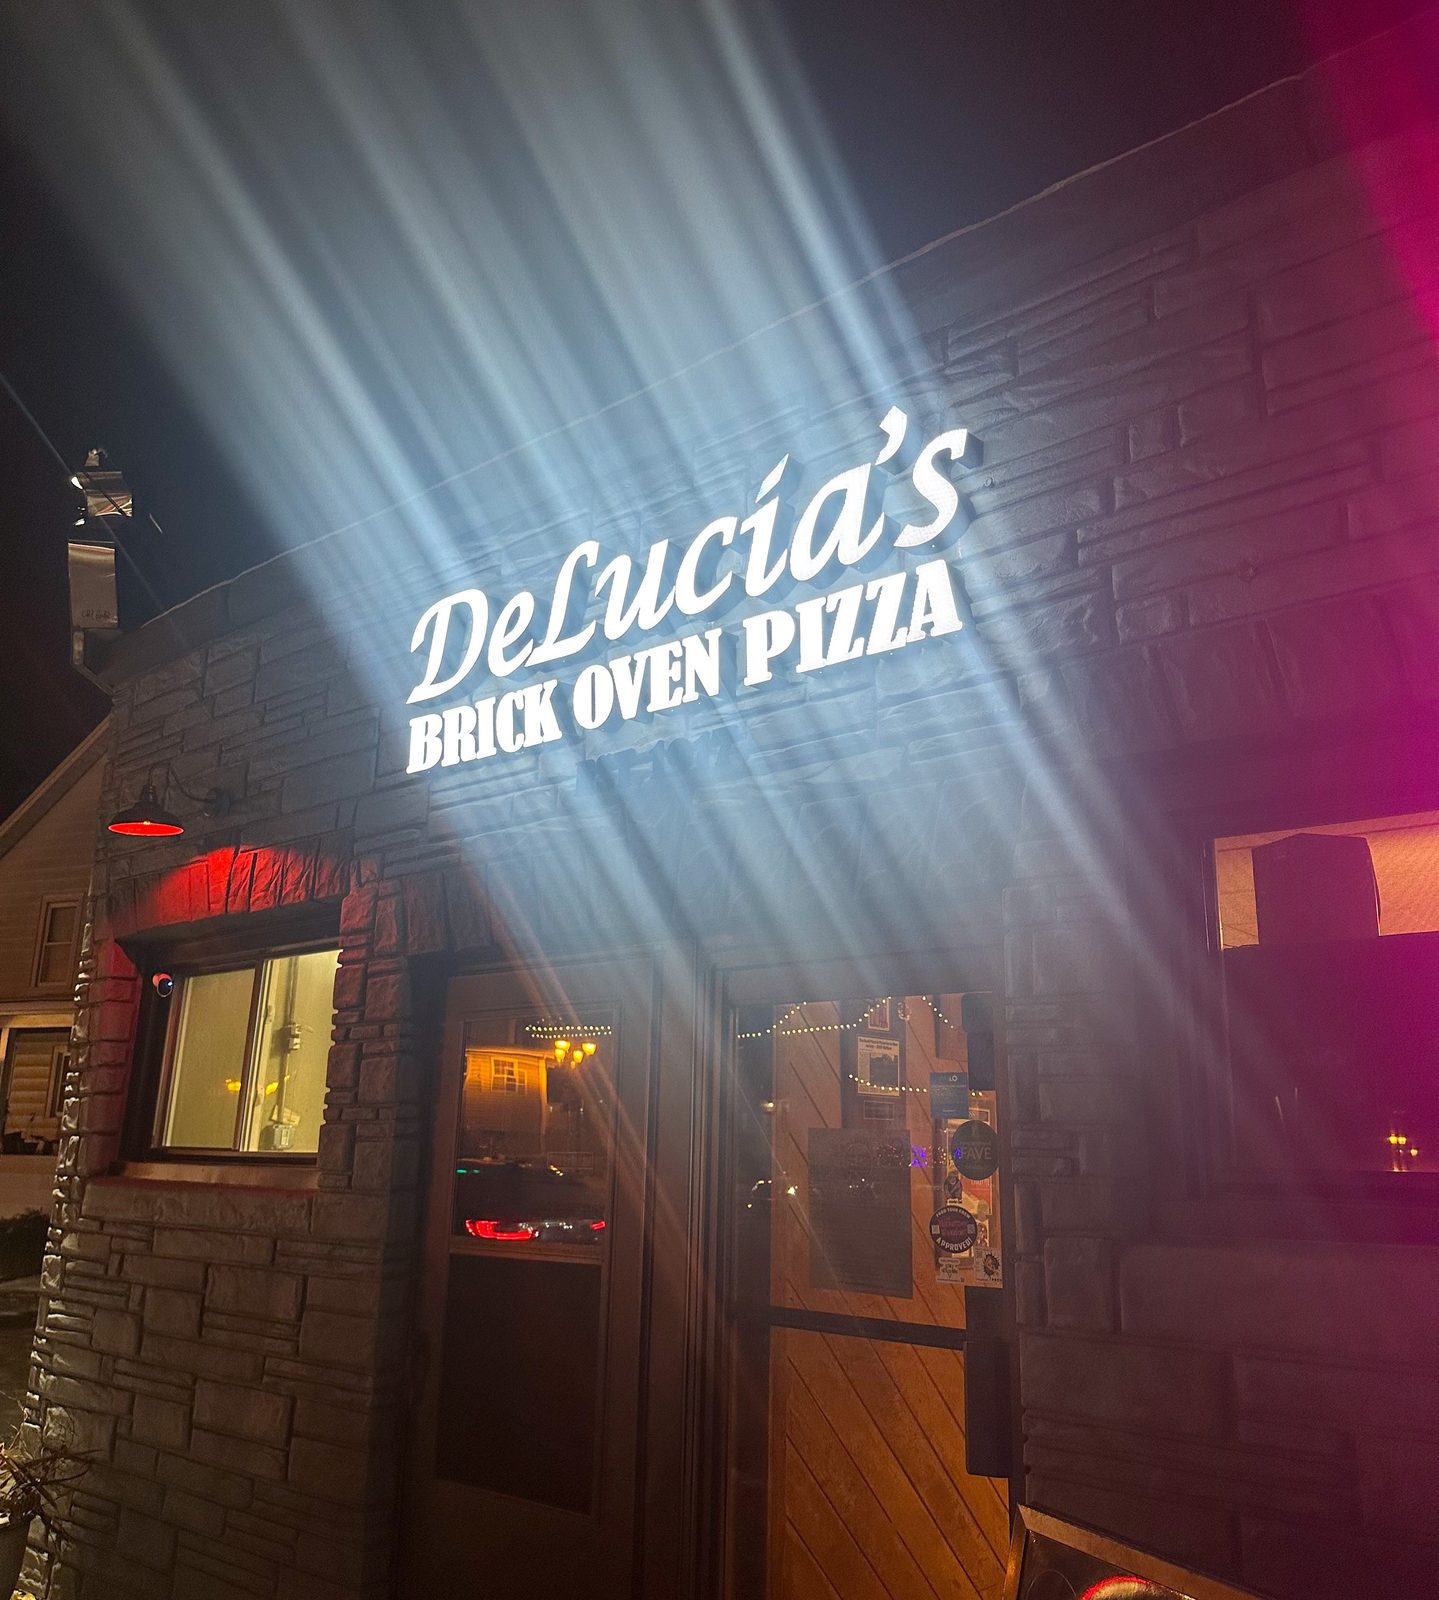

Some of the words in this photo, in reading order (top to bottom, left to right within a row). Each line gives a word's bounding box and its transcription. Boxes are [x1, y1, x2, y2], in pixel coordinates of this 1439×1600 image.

[406, 679, 562, 775] BRICK
[572, 629, 723, 731] OVEN
[742, 558, 964, 687] PIZZA
[960, 1146, 992, 1160] FAVE
